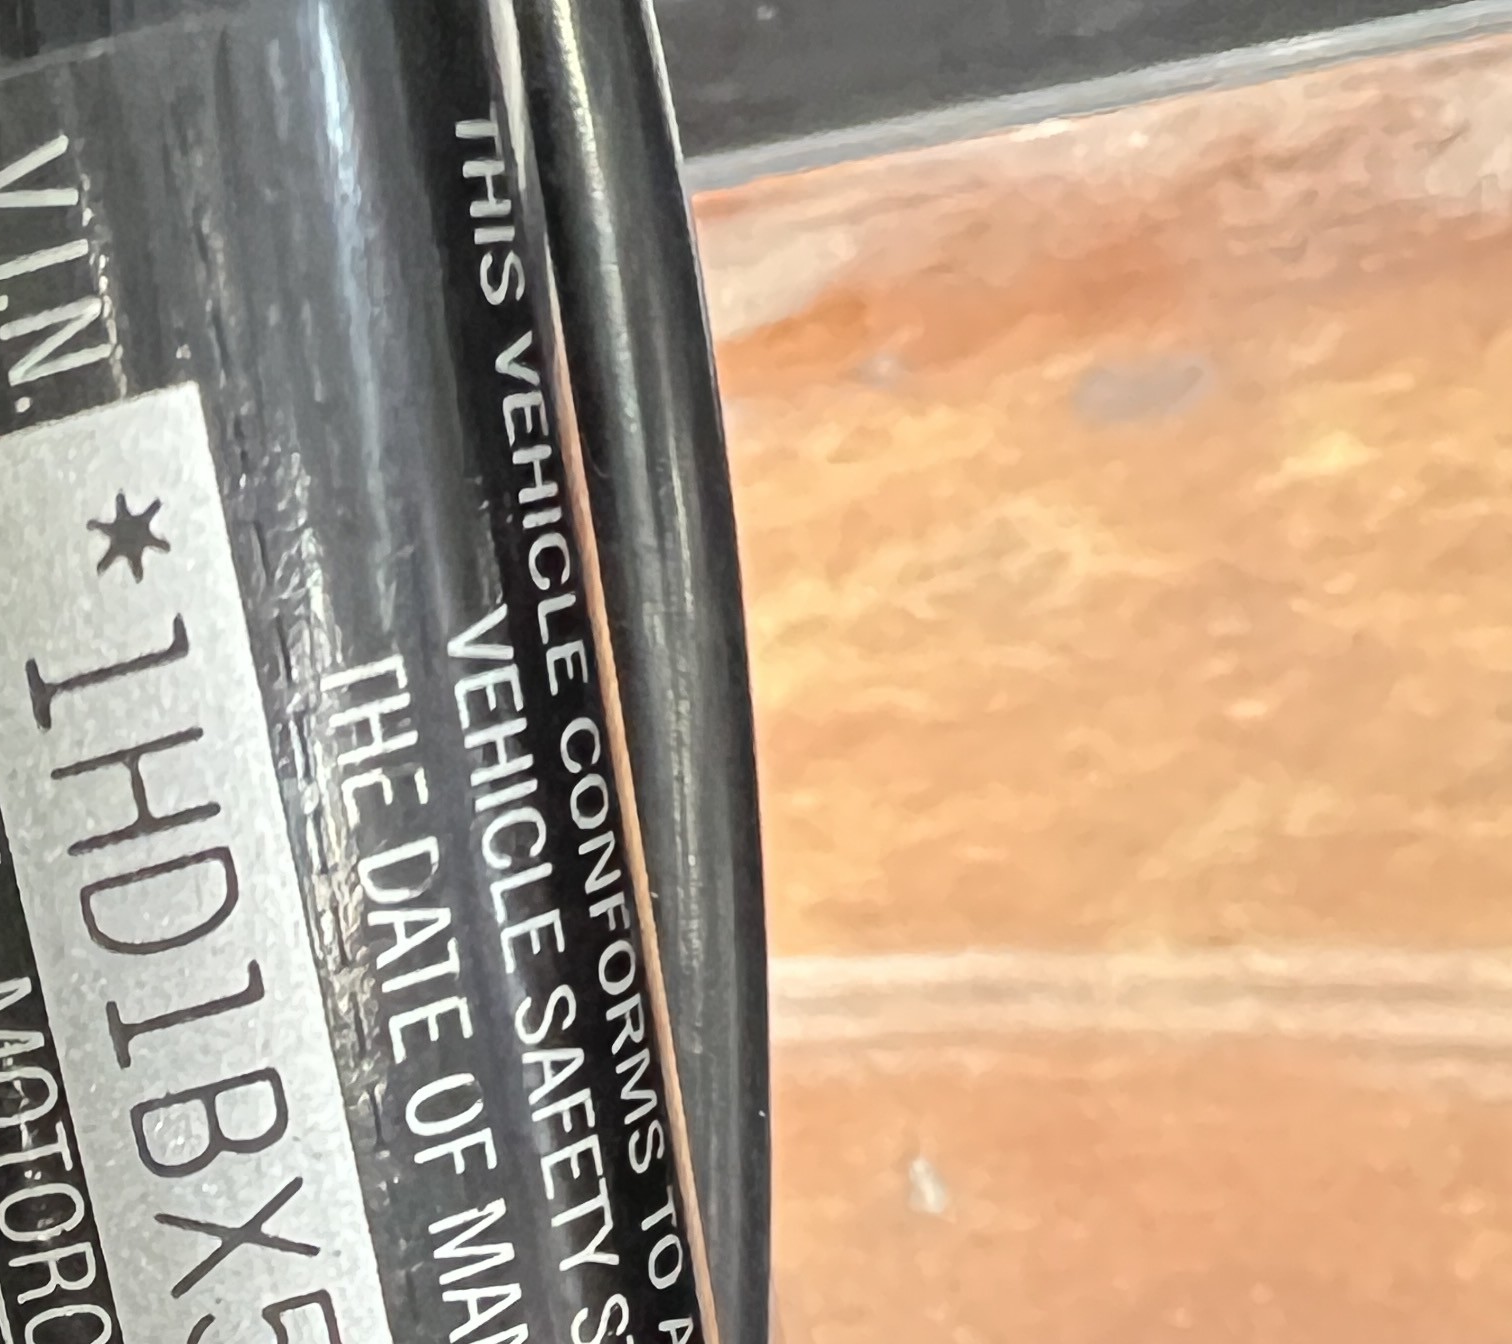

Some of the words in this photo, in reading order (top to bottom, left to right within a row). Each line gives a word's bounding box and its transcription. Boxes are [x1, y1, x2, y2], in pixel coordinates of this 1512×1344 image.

[322, 653, 429, 812] THE
[454, 106, 526, 306] THIS
[494, 330, 589, 696] VEHICLE
[559, 716, 666, 1174] CONFORMS
[640, 1184, 684, 1290] TO
[358, 838, 475, 1064] DATE
[446, 603, 566, 975] VEHICLE
[514, 984, 620, 1271] SAFETY
[404, 1072, 497, 1174] OF
